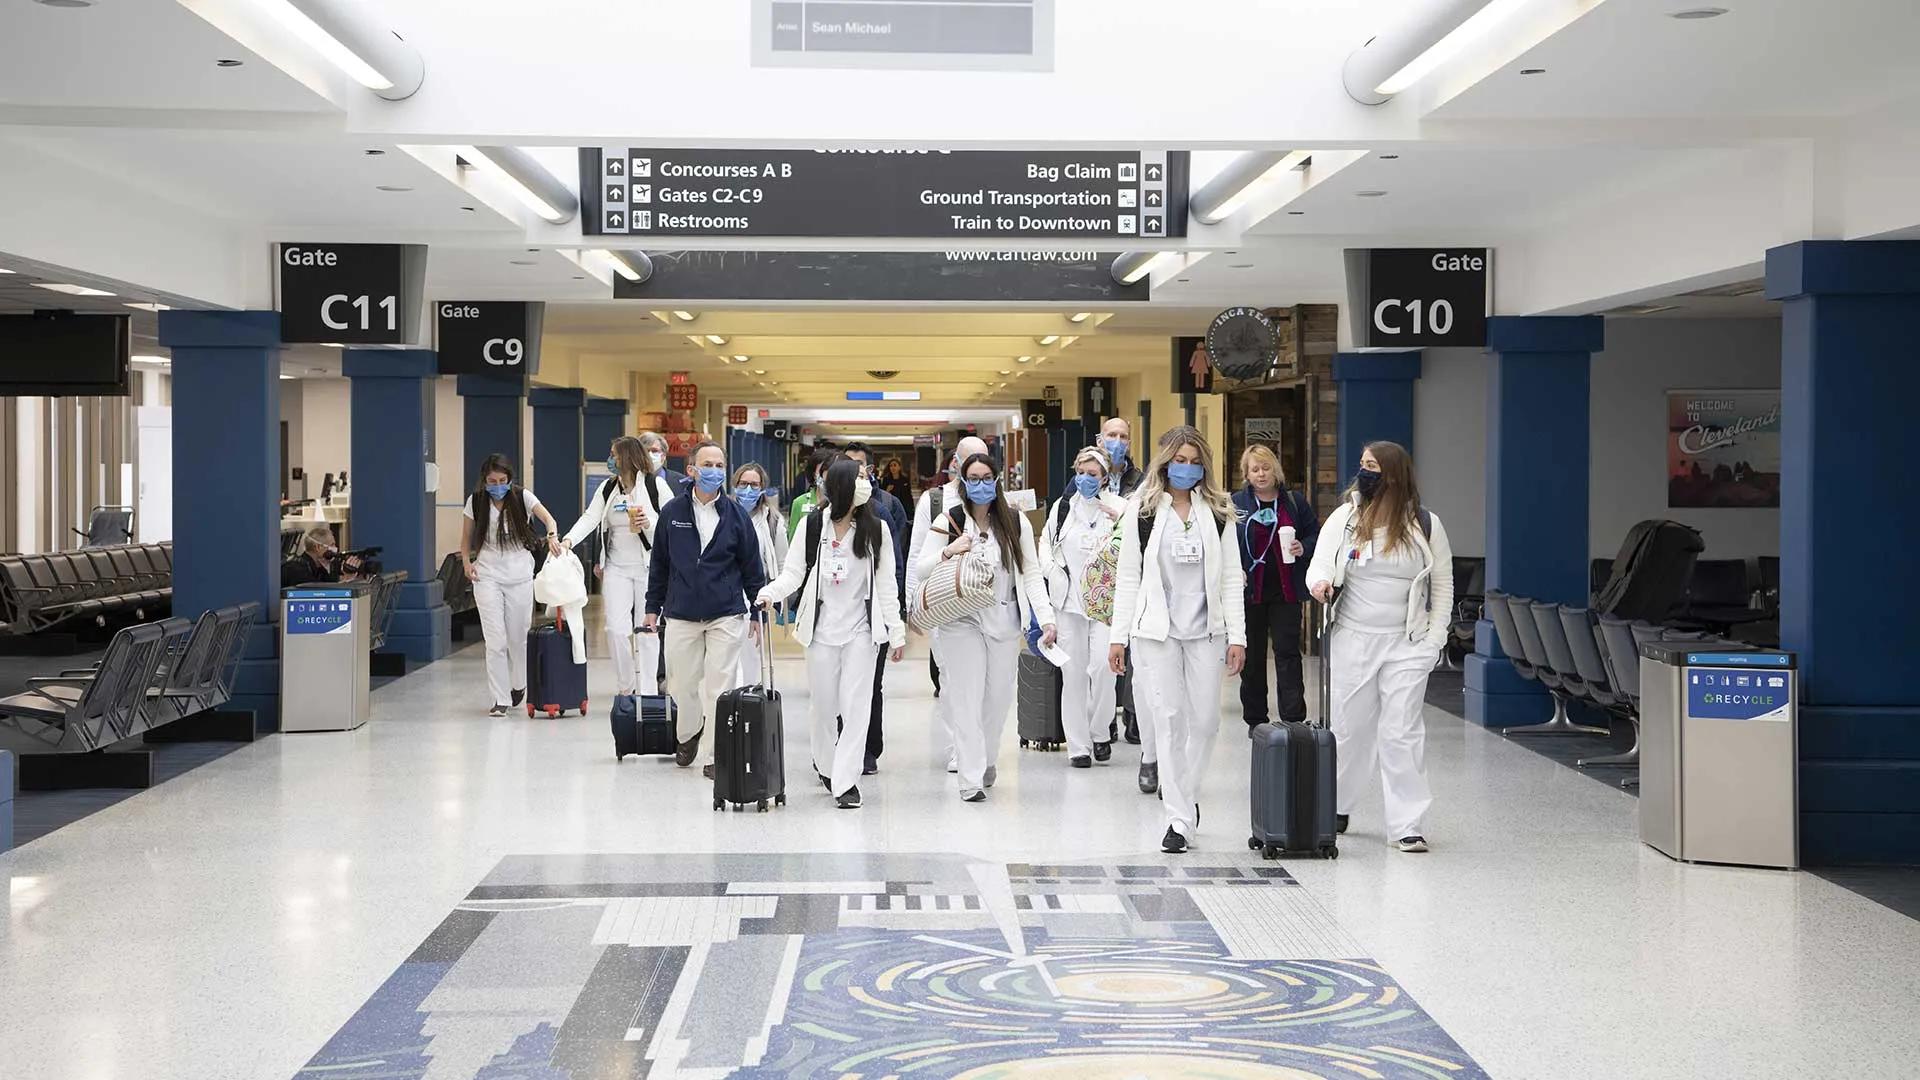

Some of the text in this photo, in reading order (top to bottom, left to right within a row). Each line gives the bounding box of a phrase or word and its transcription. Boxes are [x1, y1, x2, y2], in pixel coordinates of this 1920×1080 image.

[812, 22, 891, 34] Sean Michael
[660, 162, 792, 178] Concourses A B
[1027, 164, 1111, 182] Bag Claim
[659, 188, 763, 203] Gates C2-C9
[920, 190, 1111, 208] Ground Transportation
[658, 213, 749, 229] Restrooms
[951, 215, 1111, 230] Train to Downtown
[284, 248, 338, 266] Gate
[1432, 253, 1483, 271] Gate
[320, 294, 396, 330] C11
[441, 304, 480, 318] Gate
[1216, 308, 1269, 326] INCA TEA
[1374, 299, 1454, 334] C10
[483, 338, 524, 365] C9
[1687, 401, 1734, 410] WELCOME
[1028, 414, 1045, 425] C8
[1687, 412, 1700, 421] TO
[774, 429, 786, 438] C7
[1679, 405, 1777, 454] Cleveland
[304, 616, 341, 624] RECYCLE
[1715, 694, 1774, 705] RECYCLE
